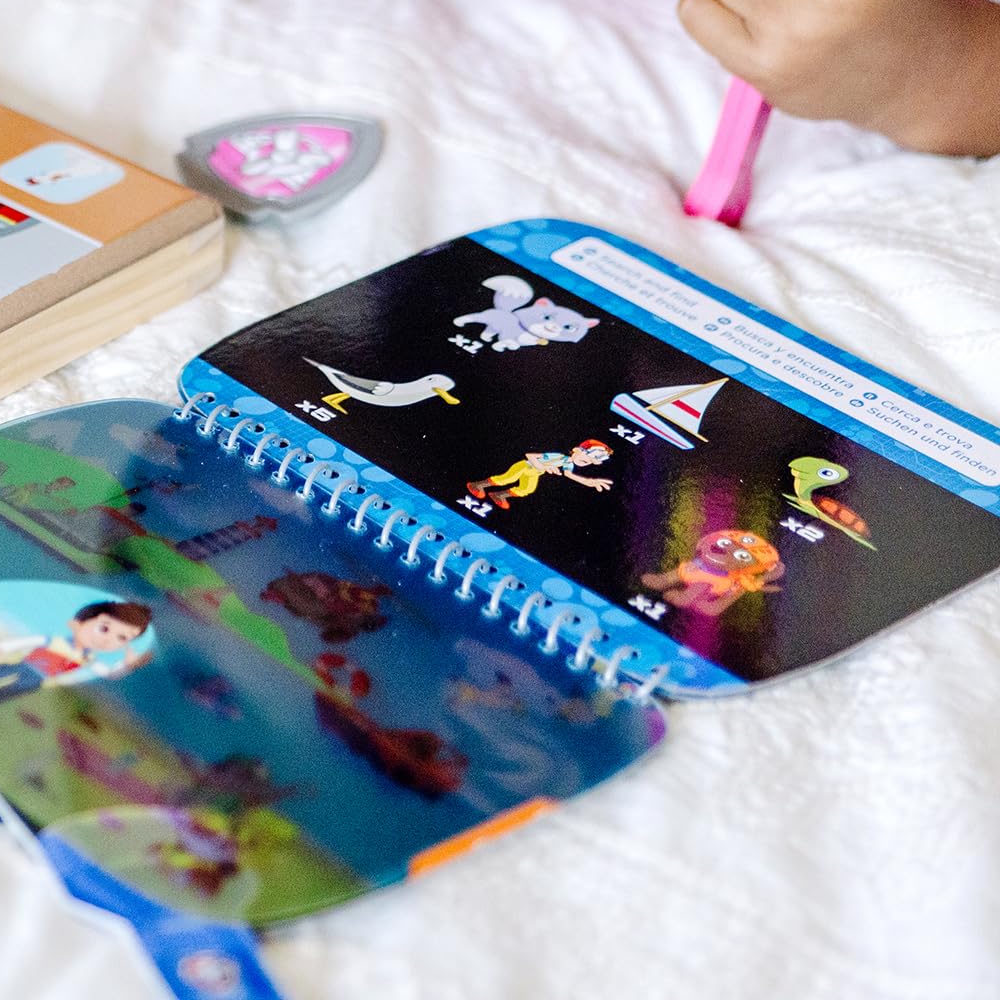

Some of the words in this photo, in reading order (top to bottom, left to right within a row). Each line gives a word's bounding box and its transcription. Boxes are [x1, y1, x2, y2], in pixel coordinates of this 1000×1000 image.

[720, 331, 769, 360] Procura
[783, 363, 845, 398] descobre
[733, 324, 773, 348] Busca
[787, 351, 855, 389] encuentra
[866, 407, 918, 436] Suchen
[920, 435, 950, 451] und
[950, 450, 997, 477] finden
[881, 400, 921, 424] Cerca
[935, 427, 974, 450] trova
